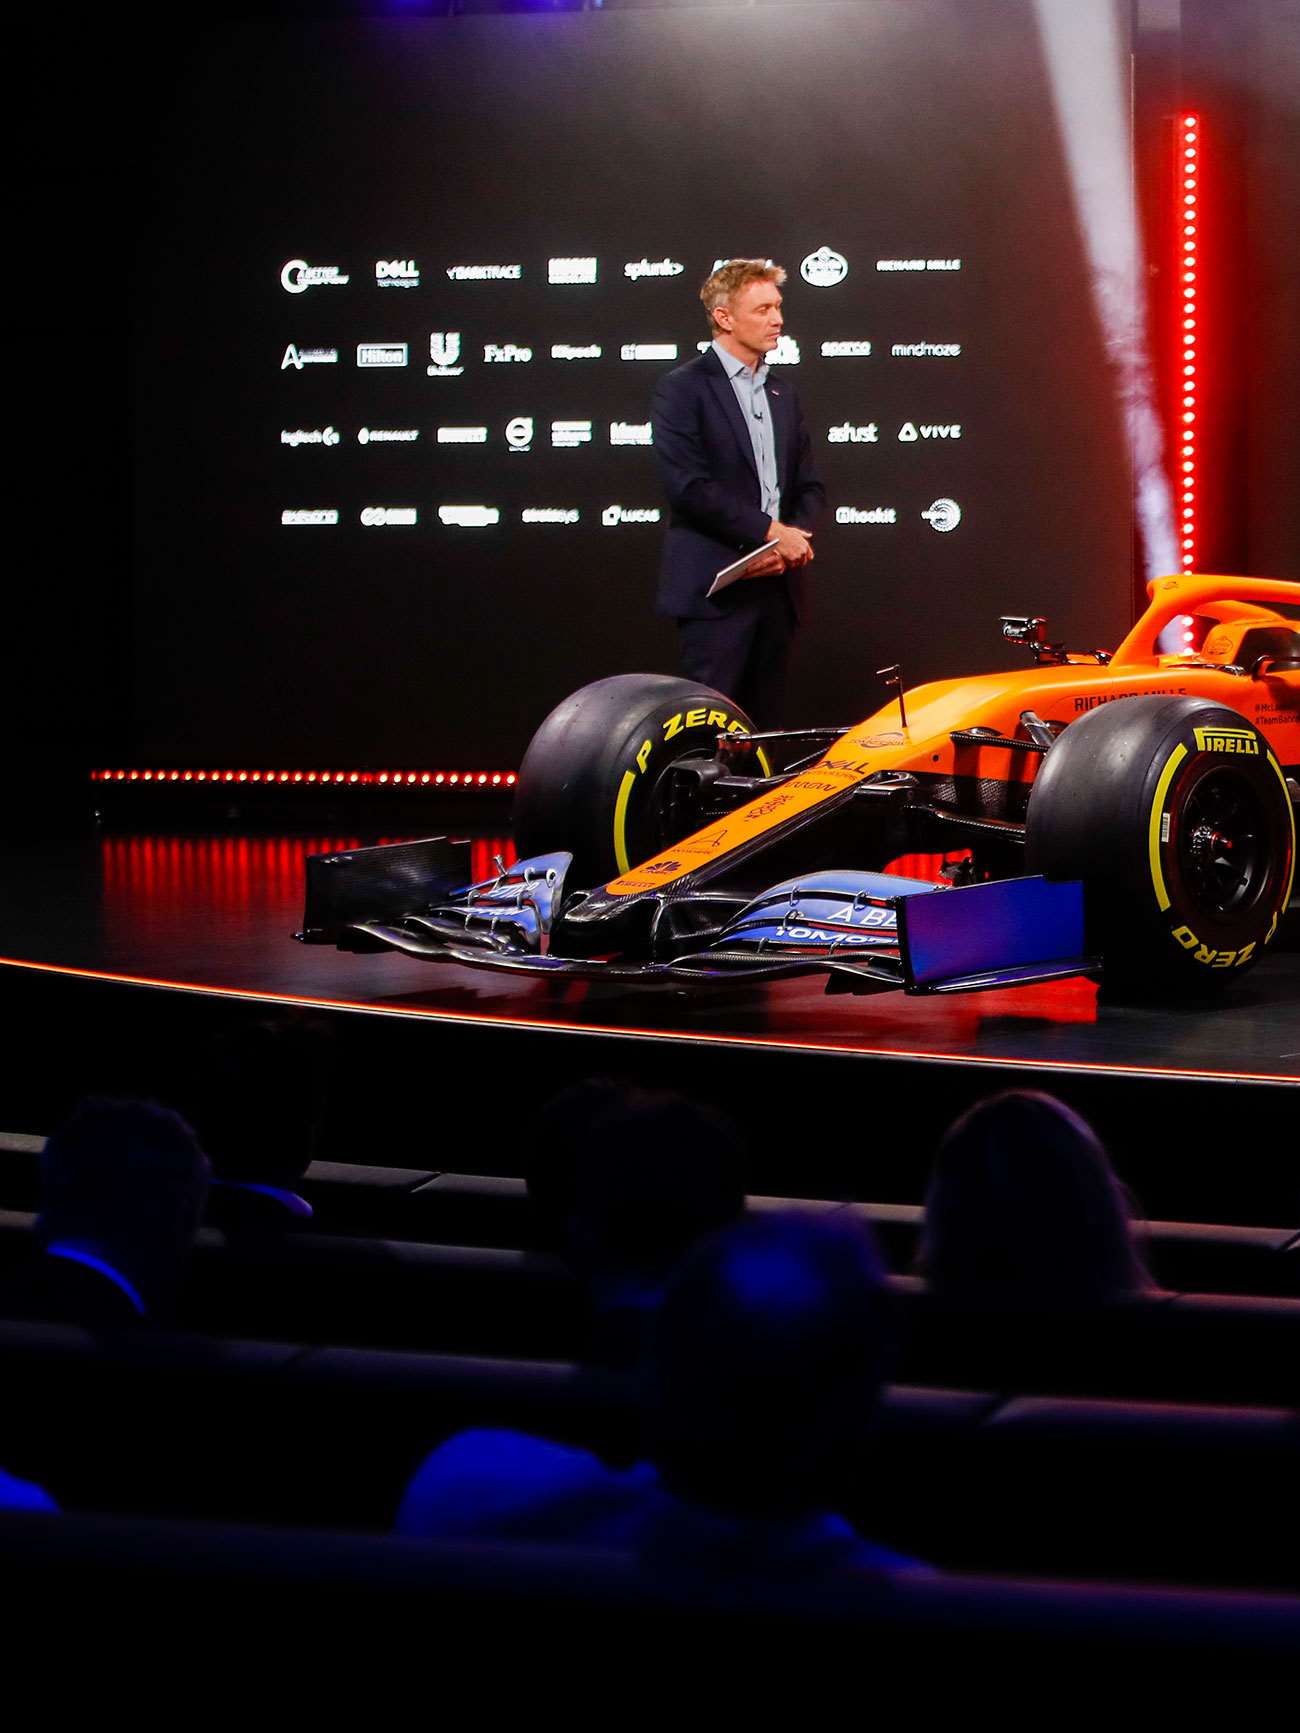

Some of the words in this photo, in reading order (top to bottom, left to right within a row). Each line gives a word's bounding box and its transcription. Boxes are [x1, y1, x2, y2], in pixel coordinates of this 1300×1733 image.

[376, 260, 420, 278] DELL
[361, 349, 403, 364] Hilton
[484, 344, 533, 363] FxPro
[920, 424, 962, 439] VIVE
[636, 739, 652, 775] P
[662, 708, 750, 742] ZERO
[1193, 727, 1259, 755] PIRELLI
[827, 905, 854, 922] A
[1171, 925, 1256, 968] ZERO
